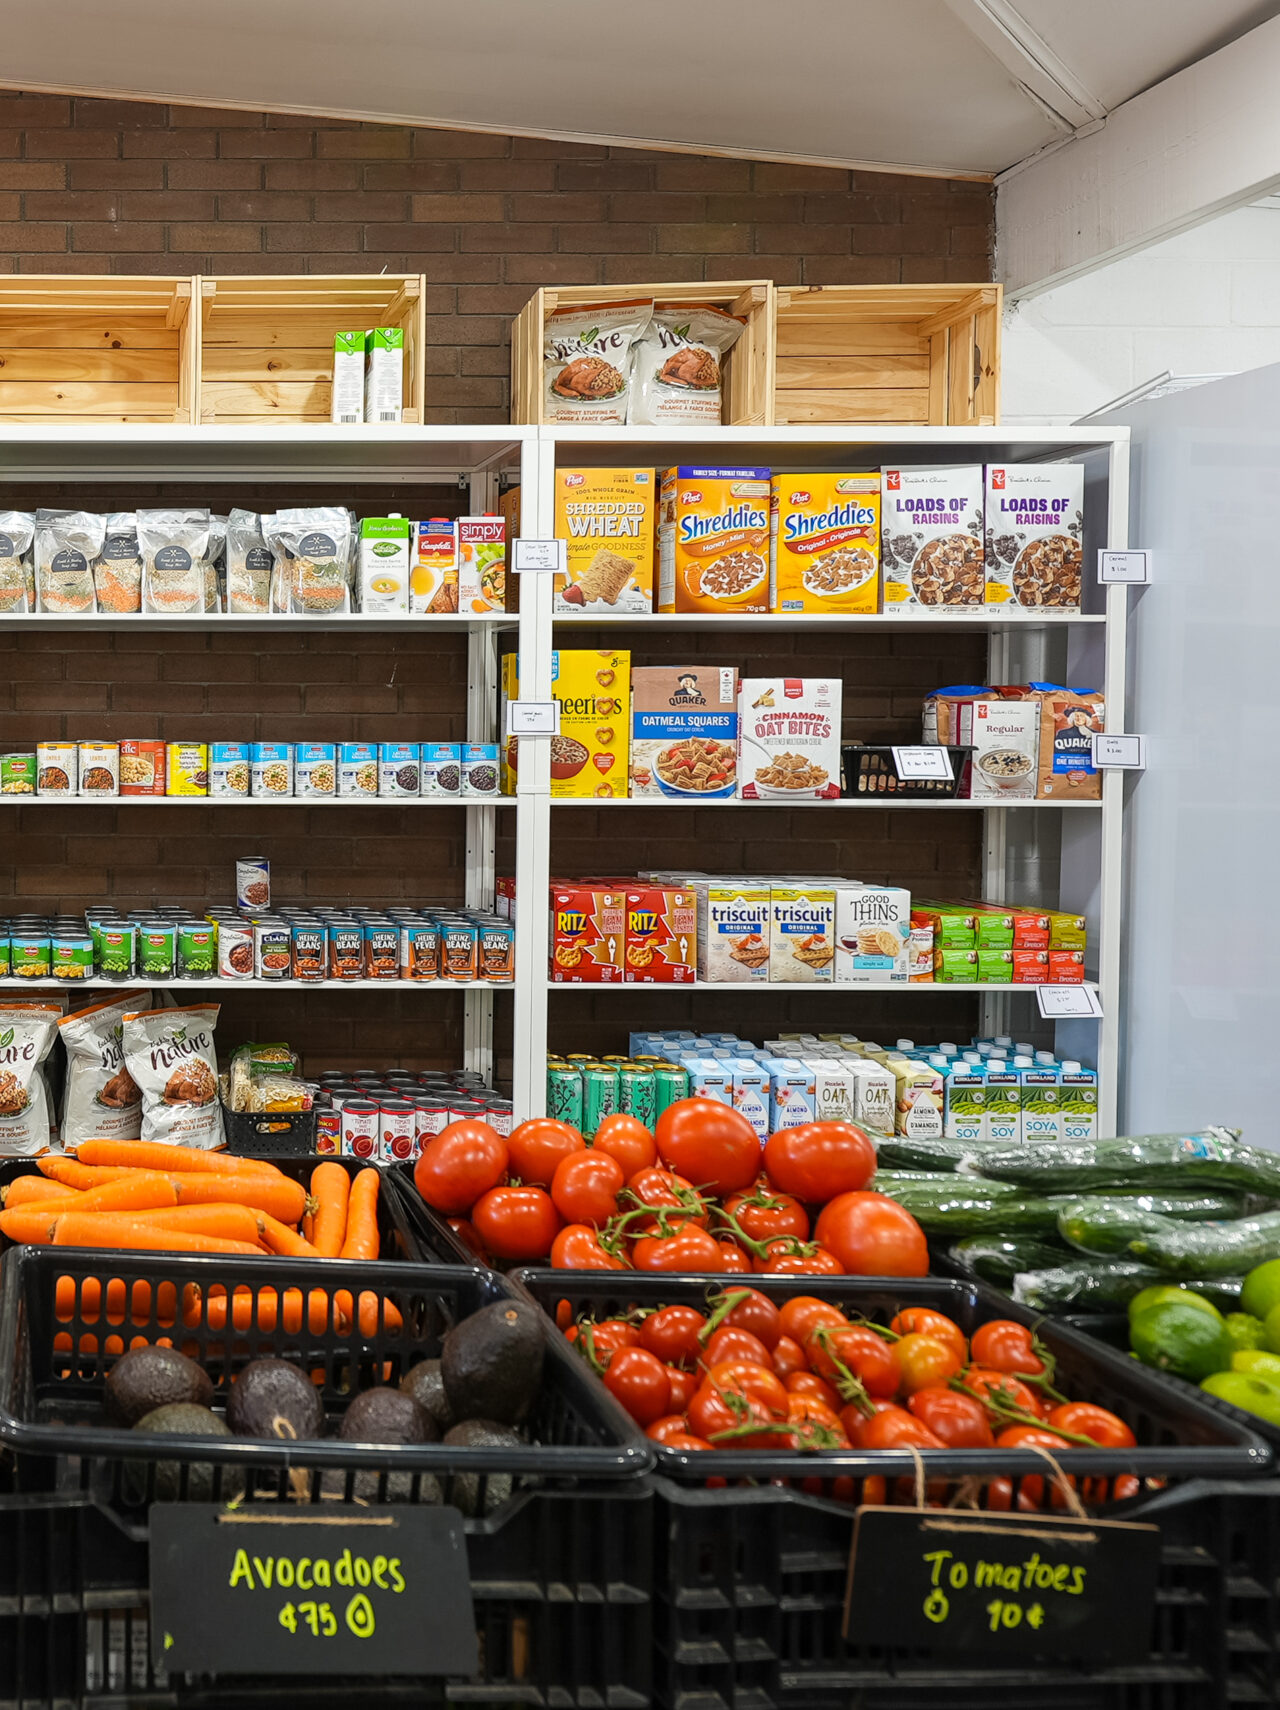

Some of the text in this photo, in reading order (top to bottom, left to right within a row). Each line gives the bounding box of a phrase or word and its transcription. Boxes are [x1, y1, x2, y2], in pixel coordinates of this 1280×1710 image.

[567, 475, 583, 486] Post
[682, 492, 701, 504] Post
[791, 492, 810, 505] Post
[566, 503, 645, 514] SHREDDED
[896, 498, 968, 512] LOADS OF
[1001, 498, 1069, 512] LOADS OF
[681, 505, 766, 540] Shreddies
[784, 501, 875, 540] Shreddies
[913, 513, 959, 525] RAISINS
[1016, 513, 1060, 525] RAISINS
[461, 525, 503, 538] simply
[568, 516, 643, 537] WHEAT
[421, 541, 451, 550] Campbell's
[702, 533, 745, 552] Honey Miel
[797, 527, 861, 553] Original Originale
[591, 542, 646, 551] GOODNESS
[669, 697, 707, 706] QUAKER
[642, 716, 730, 726] OATMEAL SQUARES
[762, 712, 825, 722] CINNAMON
[755, 721, 831, 738] OAT BITES
[986, 725, 1024, 734] Regular
[121, 743, 136, 754] clic
[862, 896, 889, 904] GOOD
[711, 906, 769, 922] triscuit
[773, 906, 832, 922] triscuit
[850, 900, 898, 922] THINS
[558, 912, 587, 931] RITZ
[629, 912, 659, 931] RITZ
[859, 920, 878, 928] gluten
[299, 933, 318, 943] HEINZ
[339, 933, 359, 942] HEINZ
[375, 933, 394, 942] HEINZ
[417, 933, 435, 943] HEINZ
[448, 933, 467, 943] HEINZ
[485, 933, 505, 942] HEINZ
[296, 941, 321, 950] BEANS
[336, 941, 361, 950] BEANS
[372, 941, 397, 950] BEANS
[446, 941, 471, 950] BEANS
[483, 941, 509, 950] BEANS
[150, 1032, 210, 1071] nature
[823, 1088, 848, 1102] OAT
[866, 1088, 890, 1102] OAT
[992, 1128, 1015, 1136] SOY
[1026, 1122, 1058, 1132] SOYA
[1065, 1127, 1090, 1137] SOY
[956, 1129, 980, 1138] SOY
[229, 1549, 405, 1592] Avocadoes
[923, 1550, 1086, 1595] Tomatoes
[988, 1600, 1022, 1632] 10
